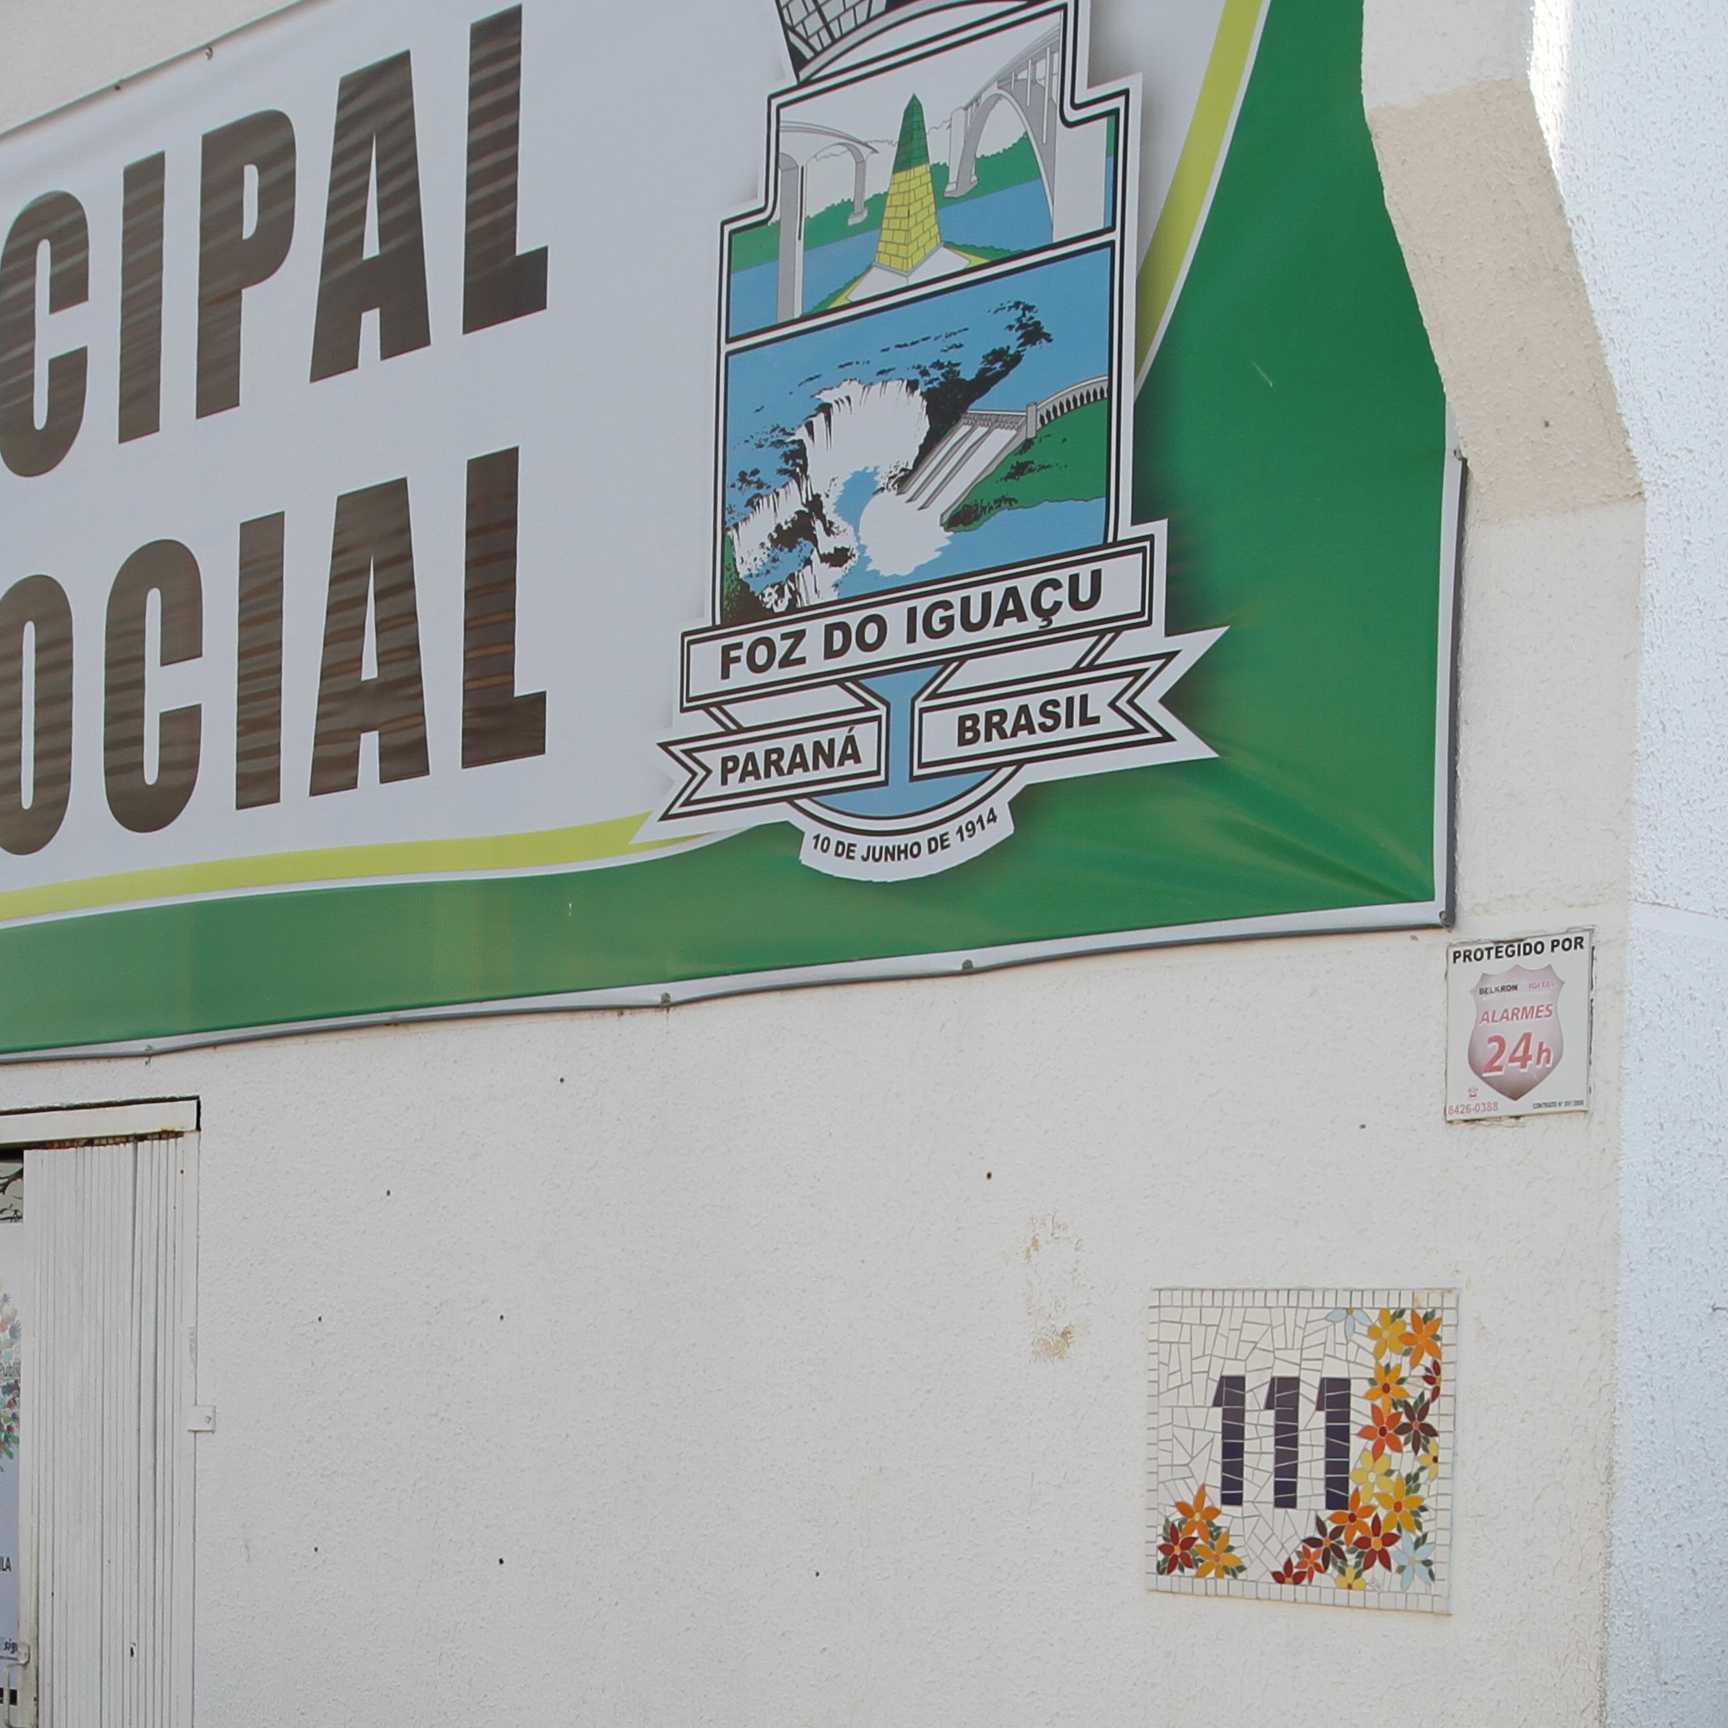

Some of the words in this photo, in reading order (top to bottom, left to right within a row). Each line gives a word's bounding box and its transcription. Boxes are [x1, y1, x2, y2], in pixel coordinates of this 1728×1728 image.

[720, 625, 806, 680] FOZ
[823, 609, 887, 657] DO
[905, 567, 1103, 646] IGUAÇU
[719, 725, 863, 787] PARANÁ
[956, 692, 1102, 747] BRASIL
[812, 832, 831, 854] 10
[834, 840, 857, 860] DE
[861, 841, 922, 863] JUNHO
[927, 831, 952, 854] DE
[955, 807, 999, 843] 1914
[1453, 941, 1545, 964] PROTEGIDO
[1550, 936, 1585, 953] POR
[1479, 1003, 1553, 1025] ALARMES
[1212, 1375, 1352, 1511] 111
